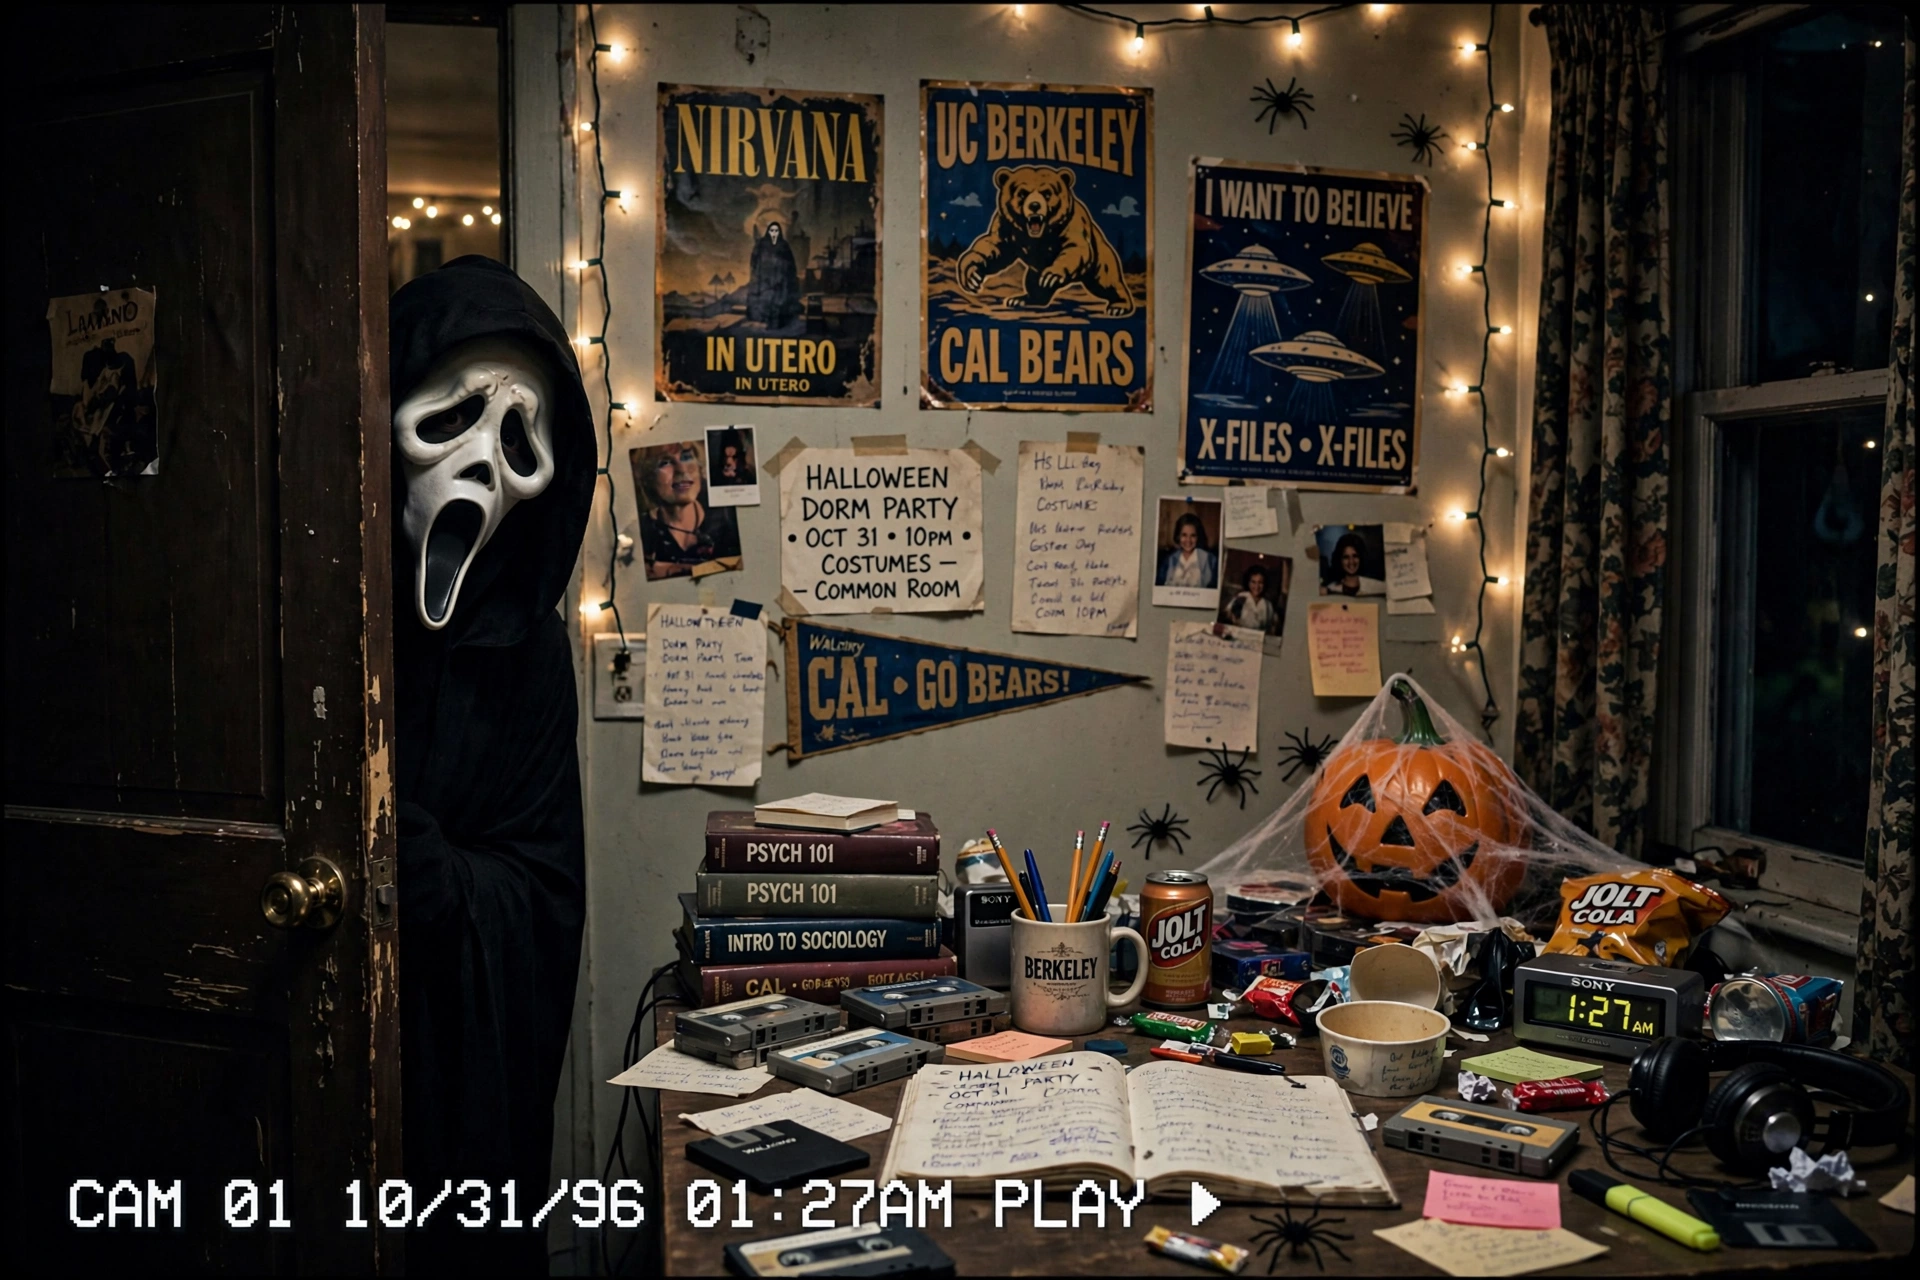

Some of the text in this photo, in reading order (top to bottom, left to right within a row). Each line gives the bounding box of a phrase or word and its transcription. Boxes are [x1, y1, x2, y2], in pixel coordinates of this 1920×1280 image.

[674, 104, 867, 183] NIRVANA
[935, 101, 1139, 177] UC BERKELEY
[1205, 179, 1412, 231] I WANT TO BELIEVE
[706, 336, 837, 375] IN UTERO
[940, 327, 1134, 387] CAL BEARS
[735, 377, 810, 393] IN UTERO
[1198, 418, 1406, 470] X-FILES X-FILES
[807, 464, 948, 490] HALLOWEEN
[802, 497, 958, 521] DORM PARTY
[806, 527, 847, 548] OCT
[857, 527, 877, 547] 31
[822, 554, 931, 575] COSTUMES
[815, 578, 960, 601] COMMON ROOM
[808, 656, 1070, 721] CAL GO BEARS!
[746, 843, 834, 863] PSYCH 101
[747, 882, 837, 904] PSYCH 101
[1570, 882, 1665, 910] JOLT
[1152, 904, 1207, 948] JOLT
[1573, 909, 1637, 925] COLA
[727, 930, 887, 952] INTRO TO SOCIOLOGY
[1160, 936, 1203, 960] COLA
[1024, 956, 1098, 980] BERKELEY
[745, 978, 787, 996] CAL
[1571, 977, 1615, 991] SONY
[1568, 994, 1653, 1035] 1:27 AM
[959, 1058, 1075, 1083] HALLOWEEN
